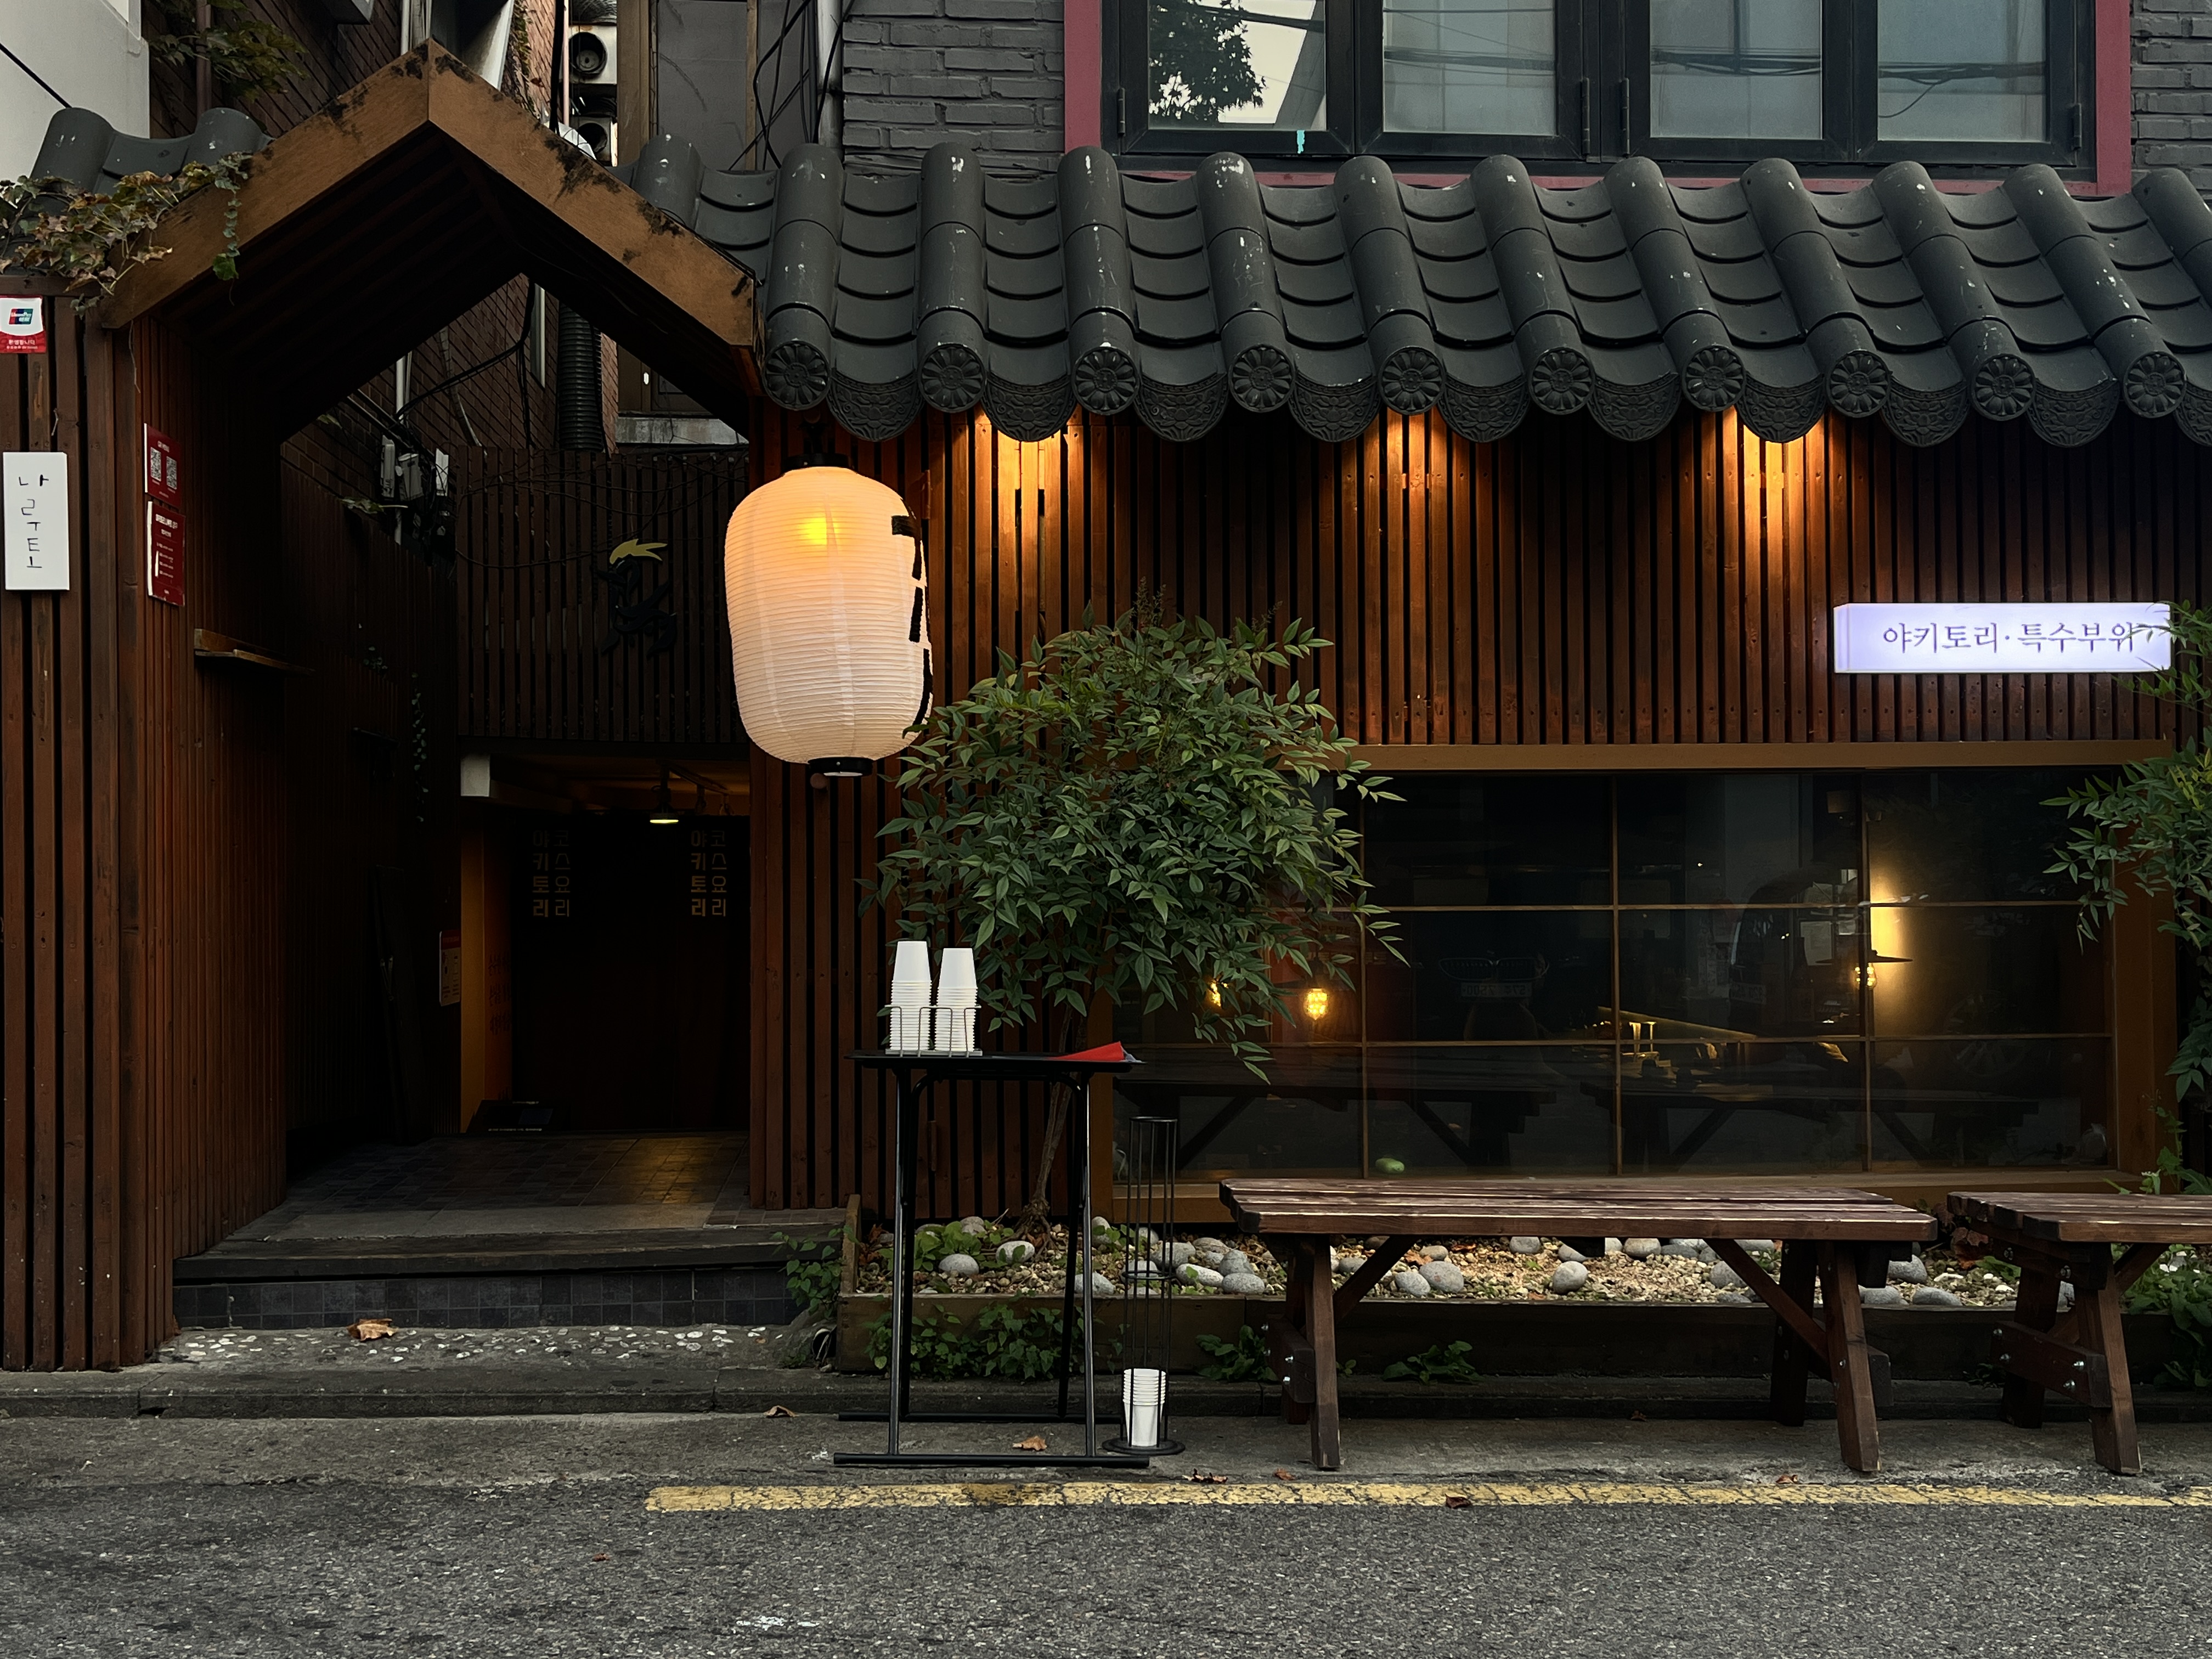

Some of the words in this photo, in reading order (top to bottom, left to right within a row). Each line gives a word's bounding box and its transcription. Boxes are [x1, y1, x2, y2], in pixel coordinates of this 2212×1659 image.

[533, 830, 549, 917] 야키토리
[554, 830, 571, 917] 코스요리
[691, 830, 707, 917] 야키토리
[711, 830, 727, 917] 코스요리
